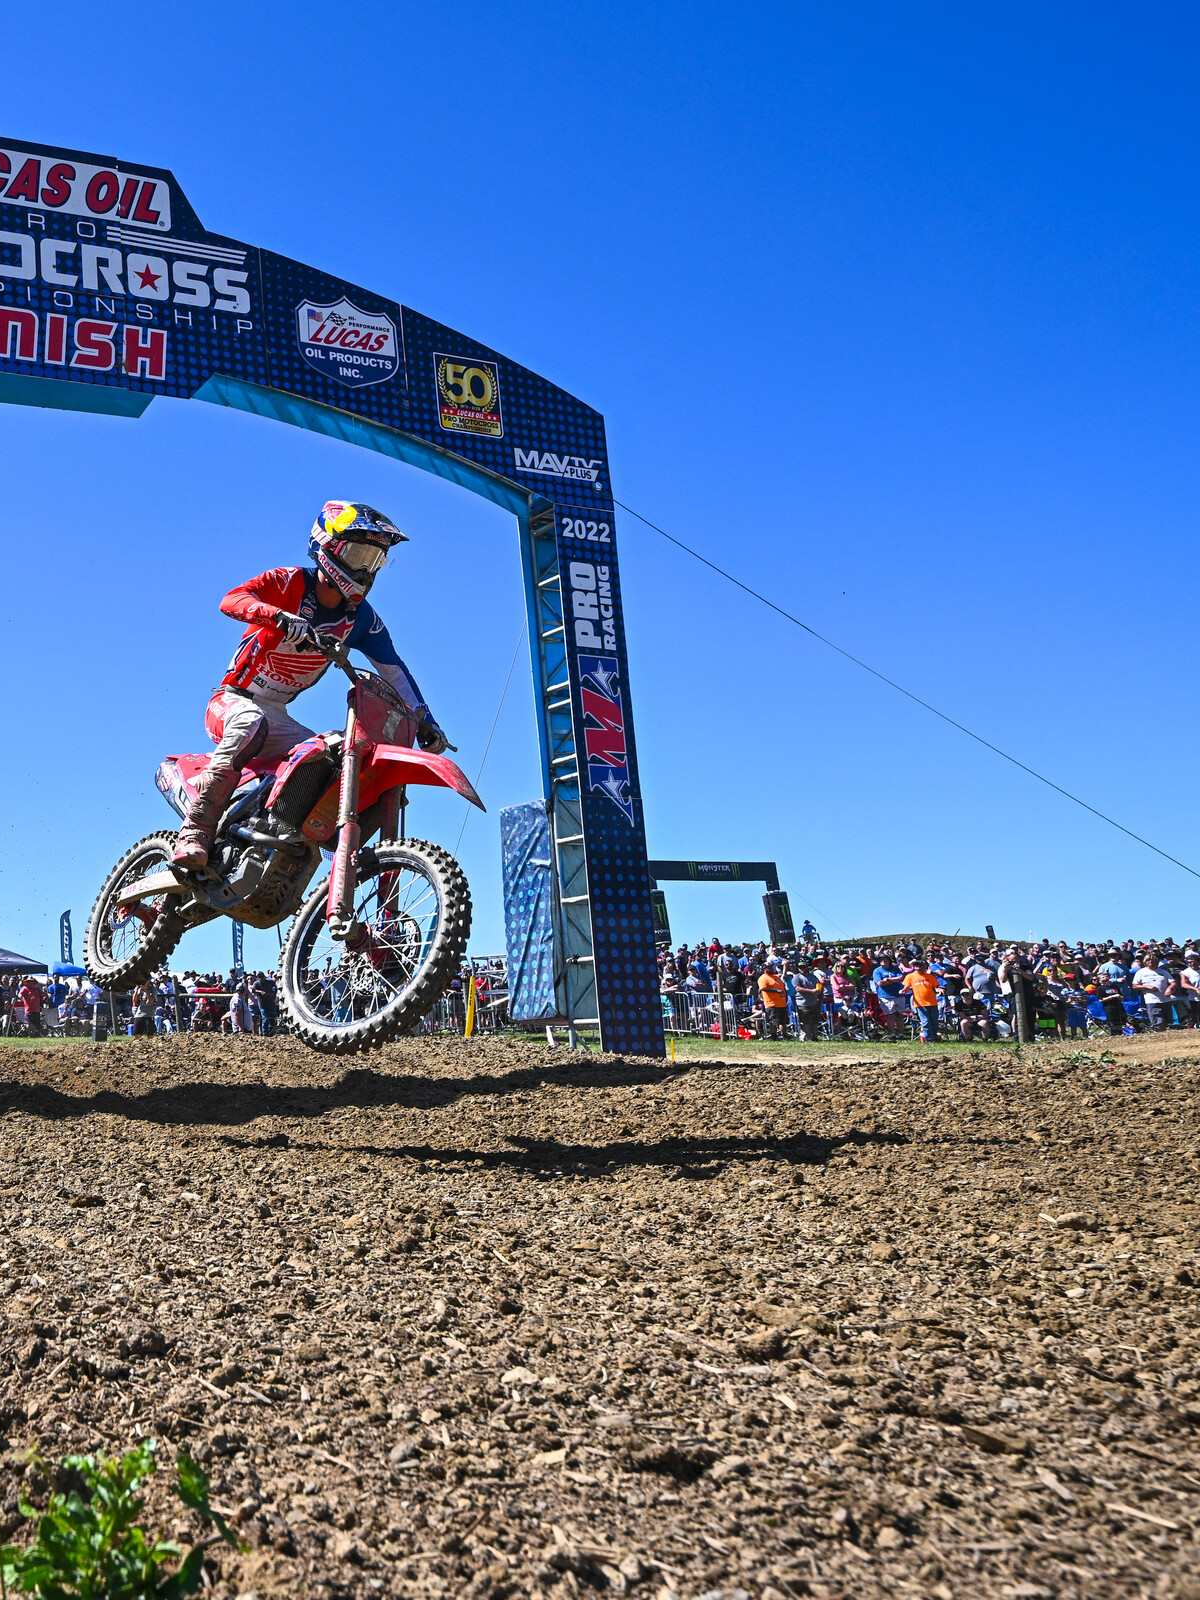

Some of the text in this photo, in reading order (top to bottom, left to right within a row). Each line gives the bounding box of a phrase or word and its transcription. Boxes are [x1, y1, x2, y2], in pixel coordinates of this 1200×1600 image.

[85, 170, 162, 225] OIL
[309, 324, 389, 352] LUCAS
[348, 321, 390, 333] PERFORMANCE
[305, 347, 392, 370] OIL PRODUCTS
[446, 363, 492, 407] 50
[443, 415, 499, 429] PRO MOTOCROSS
[457, 410, 475, 418] LUCAS
[514, 447, 602, 473] MAVTV
[570, 468, 592, 480] PLUS
[562, 517, 611, 543] 2022
[570, 561, 602, 649] PRO
[596, 565, 617, 651] RACING
[577, 653, 635, 828] AMA
